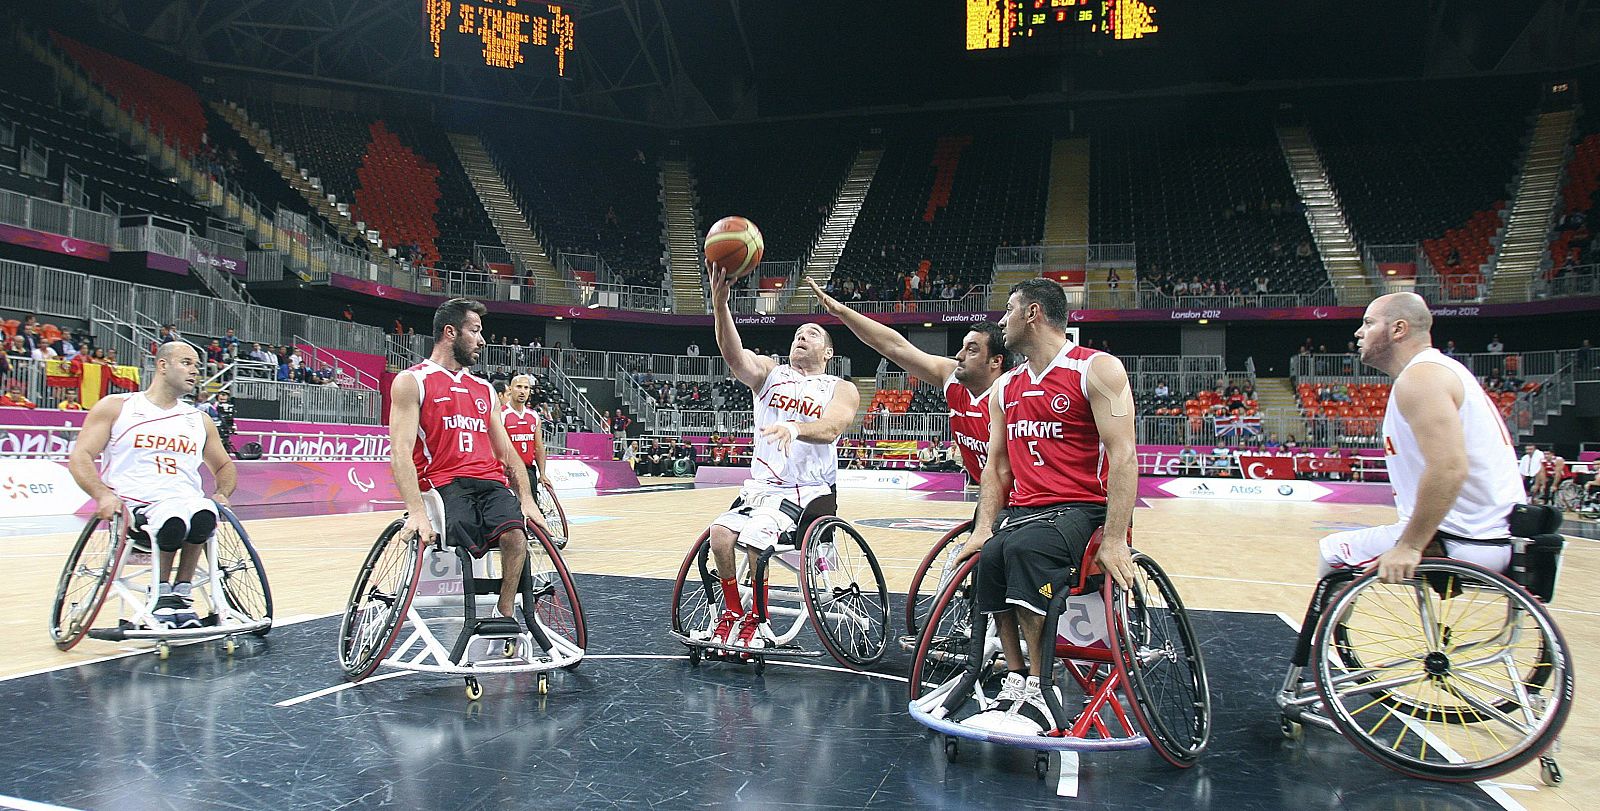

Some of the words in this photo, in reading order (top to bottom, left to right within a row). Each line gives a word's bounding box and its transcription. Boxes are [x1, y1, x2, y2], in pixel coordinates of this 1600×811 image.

[479, 7, 501, 17] FIELD
[507, 12, 529, 22] GOALS
[548, 5, 560, 14] TUR
[493, 17, 520, 28] POINTS
[1032, 14, 1045, 24] 32
[1057, 12, 1063, 21] 3
[1079, 10, 1092, 21] 36
[478, 28, 496, 38] FREE
[502, 32, 528, 43] THROWS
[492, 24, 519, 35] POINTS
[487, 44, 519, 55] ASSISTS
[482, 50, 523, 63] TURNOVERS
[486, 58, 514, 68] STEALS
[1171, 310, 1200, 318] London
[1202, 310, 1221, 318] 2012
[1430, 308, 1457, 316] ondon
[1458, 307, 1480, 316] 2012
[134, 434, 197, 455] ESPAÑA
[268, 430, 347, 460] London
[459, 431, 473, 452] 13
[522, 442, 527, 453] 9
[1028, 441, 1044, 466] 5
[156, 456, 177, 474] 13
[1008, 677, 1021, 685] NIKE
